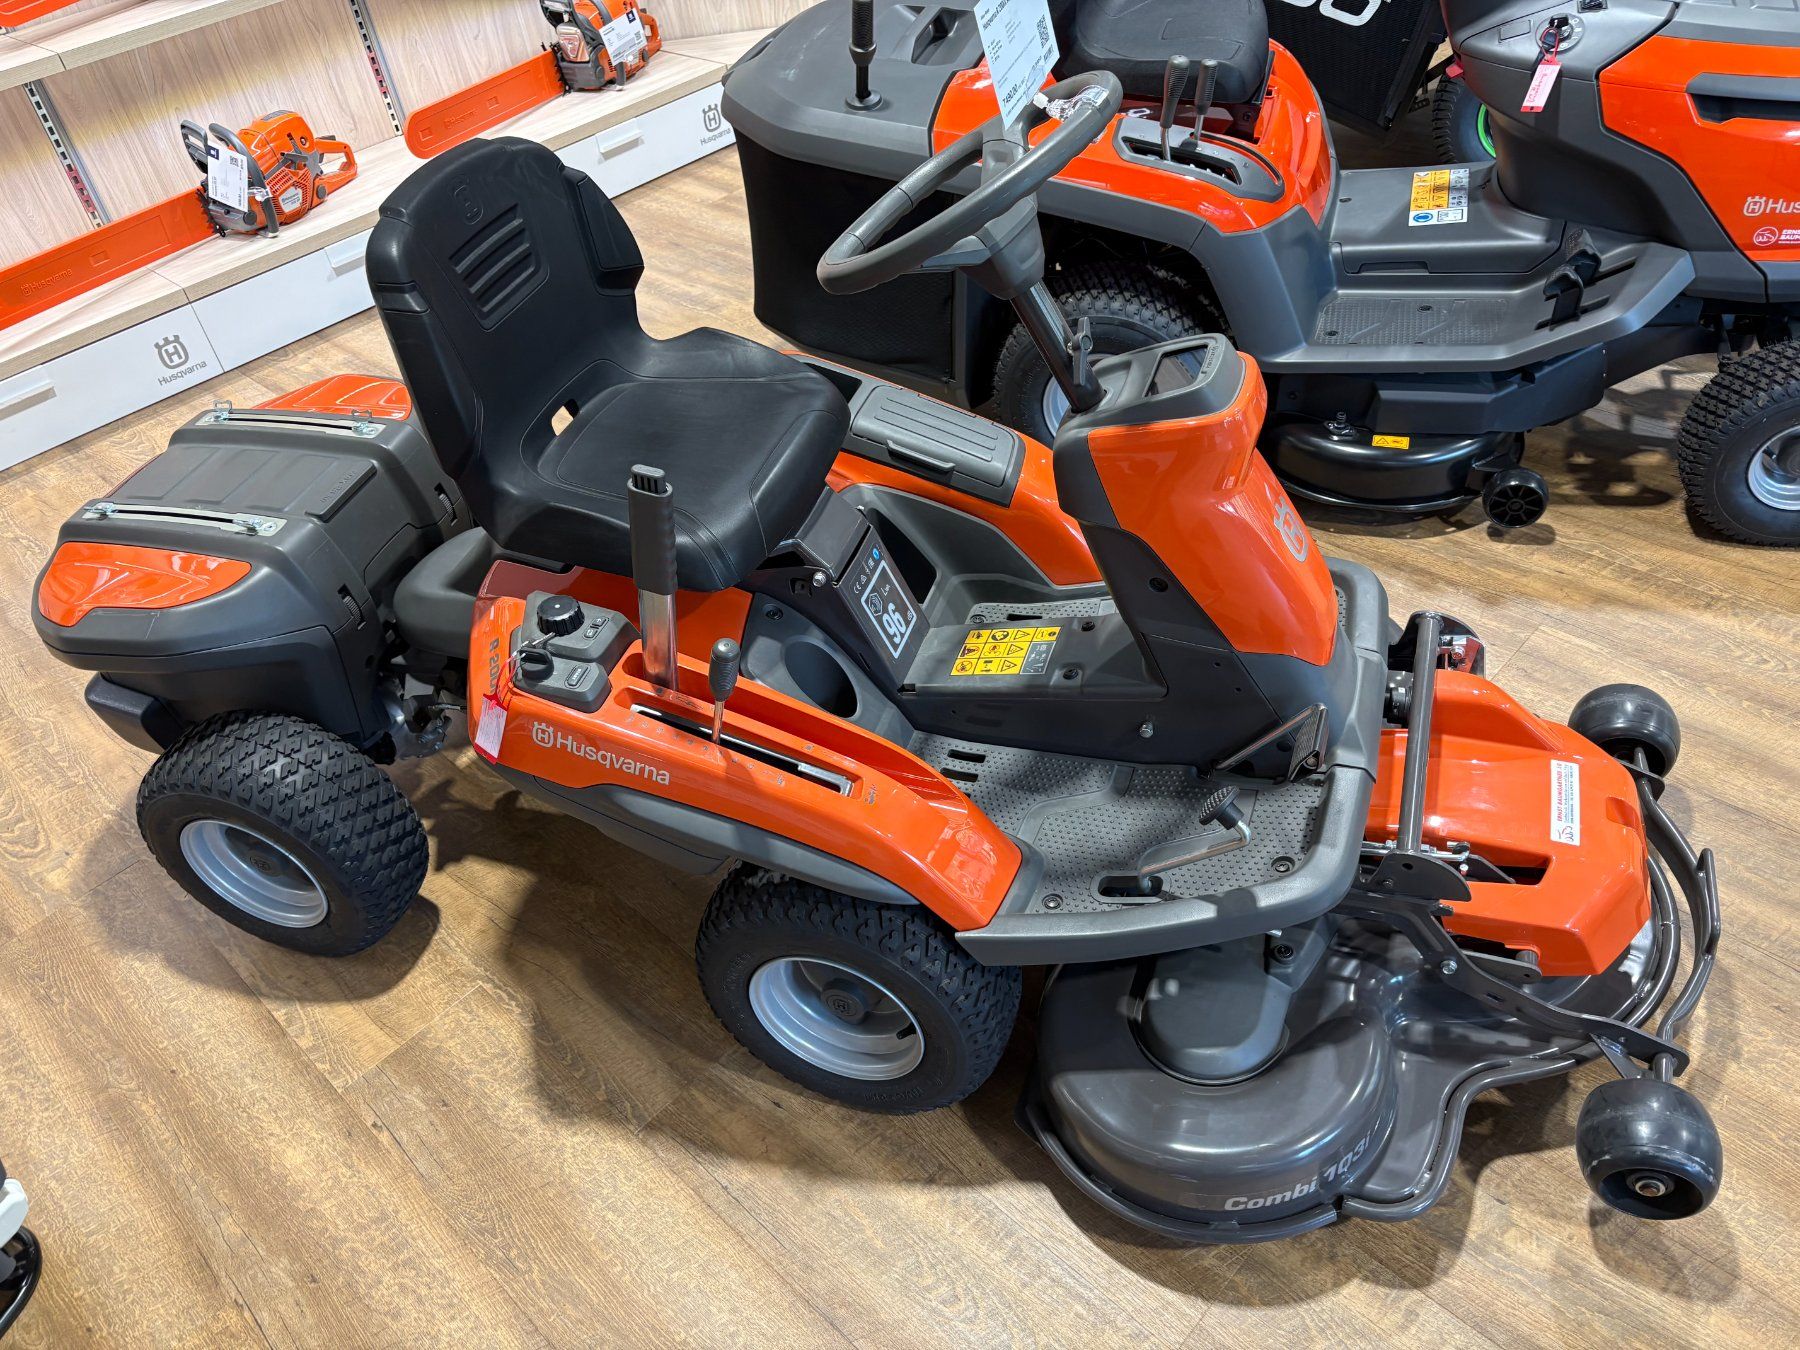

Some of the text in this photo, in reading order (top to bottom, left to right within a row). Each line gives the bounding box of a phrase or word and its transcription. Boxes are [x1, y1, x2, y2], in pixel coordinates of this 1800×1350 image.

[700, 128, 732, 145] Husqvarna
[30, 268, 73, 290] Husqvarna
[157, 360, 208, 386] Husqvarna
[882, 602, 907, 645] 96
[489, 638, 500, 653] R
[556, 731, 670, 786] Husqvarna
[1224, 1130, 1372, 1211] Combi 103i
